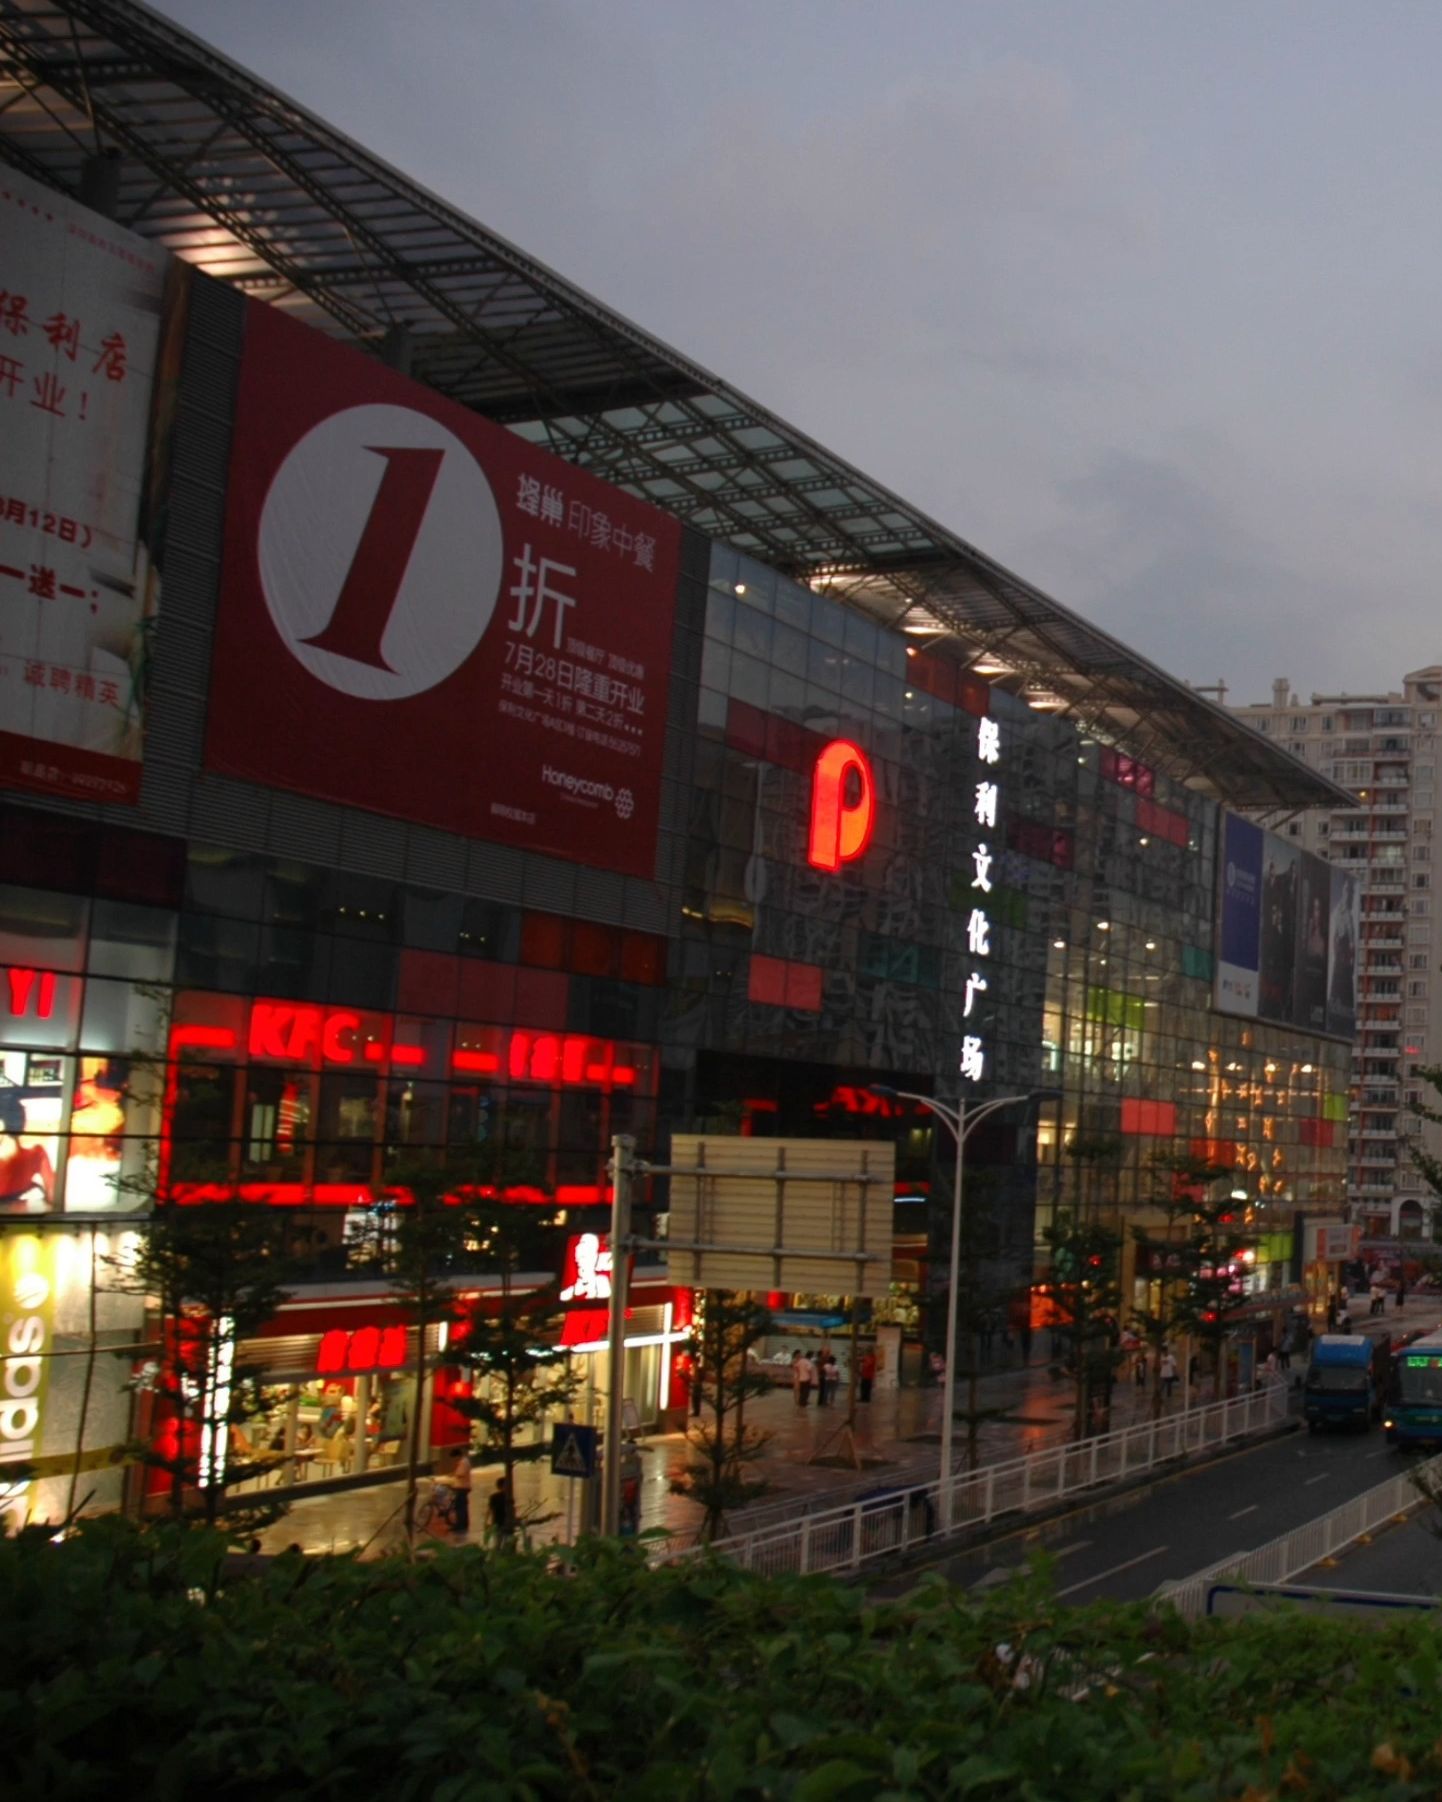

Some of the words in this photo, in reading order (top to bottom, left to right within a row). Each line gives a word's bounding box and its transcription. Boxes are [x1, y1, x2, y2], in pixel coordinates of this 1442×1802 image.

[508, 542, 577, 650] 折
[504, 641, 646, 716] 7月28日隆重开业
[541, 764, 615, 801] Honeycomb
[960, 716, 1000, 1082] 保利文化广场
[250, 1003, 359, 1063] KFC
